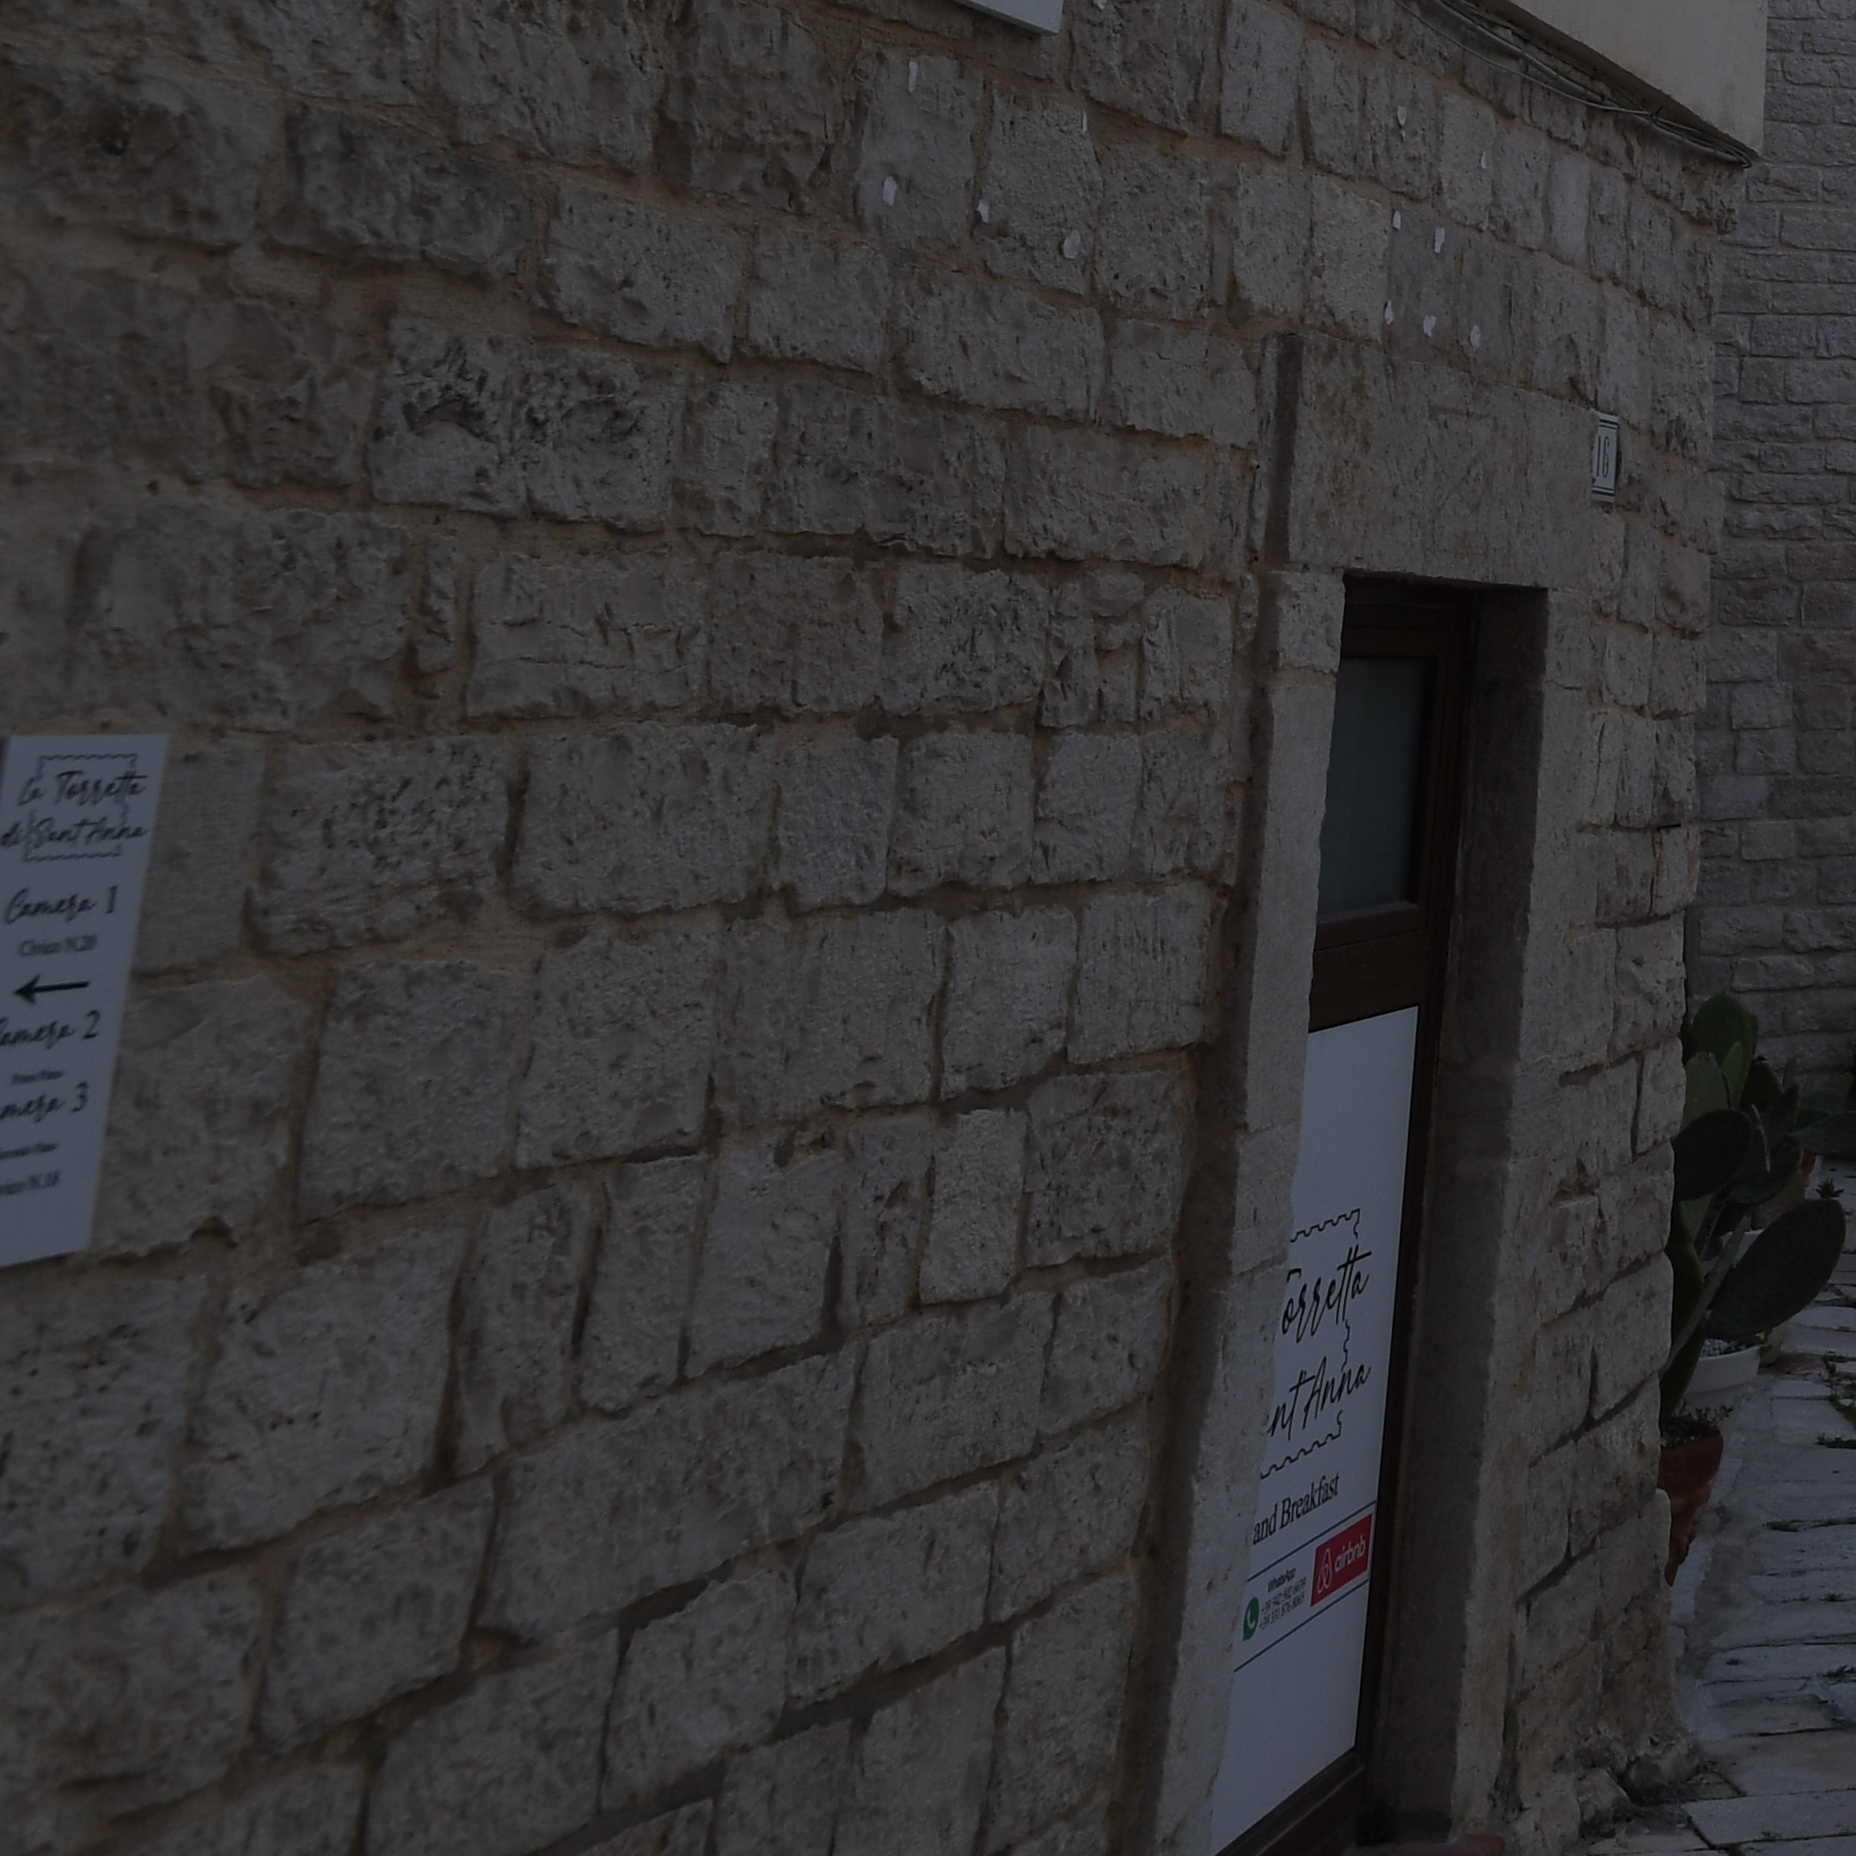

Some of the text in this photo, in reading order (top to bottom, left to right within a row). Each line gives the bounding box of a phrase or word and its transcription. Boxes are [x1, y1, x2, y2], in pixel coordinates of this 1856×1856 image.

[1596, 435, 1611, 479] 16
[18, 770, 149, 806] La Torretta
[4, 885, 118, 924] Camera 1
[81, 1009, 101, 1040] 2
[71, 1081, 88, 1112] 3
[1267, 1355, 1373, 1442] nt'Anna
[1252, 1471, 1341, 1546] and Breakfast
[1334, 1533, 1367, 1573] airbnb
